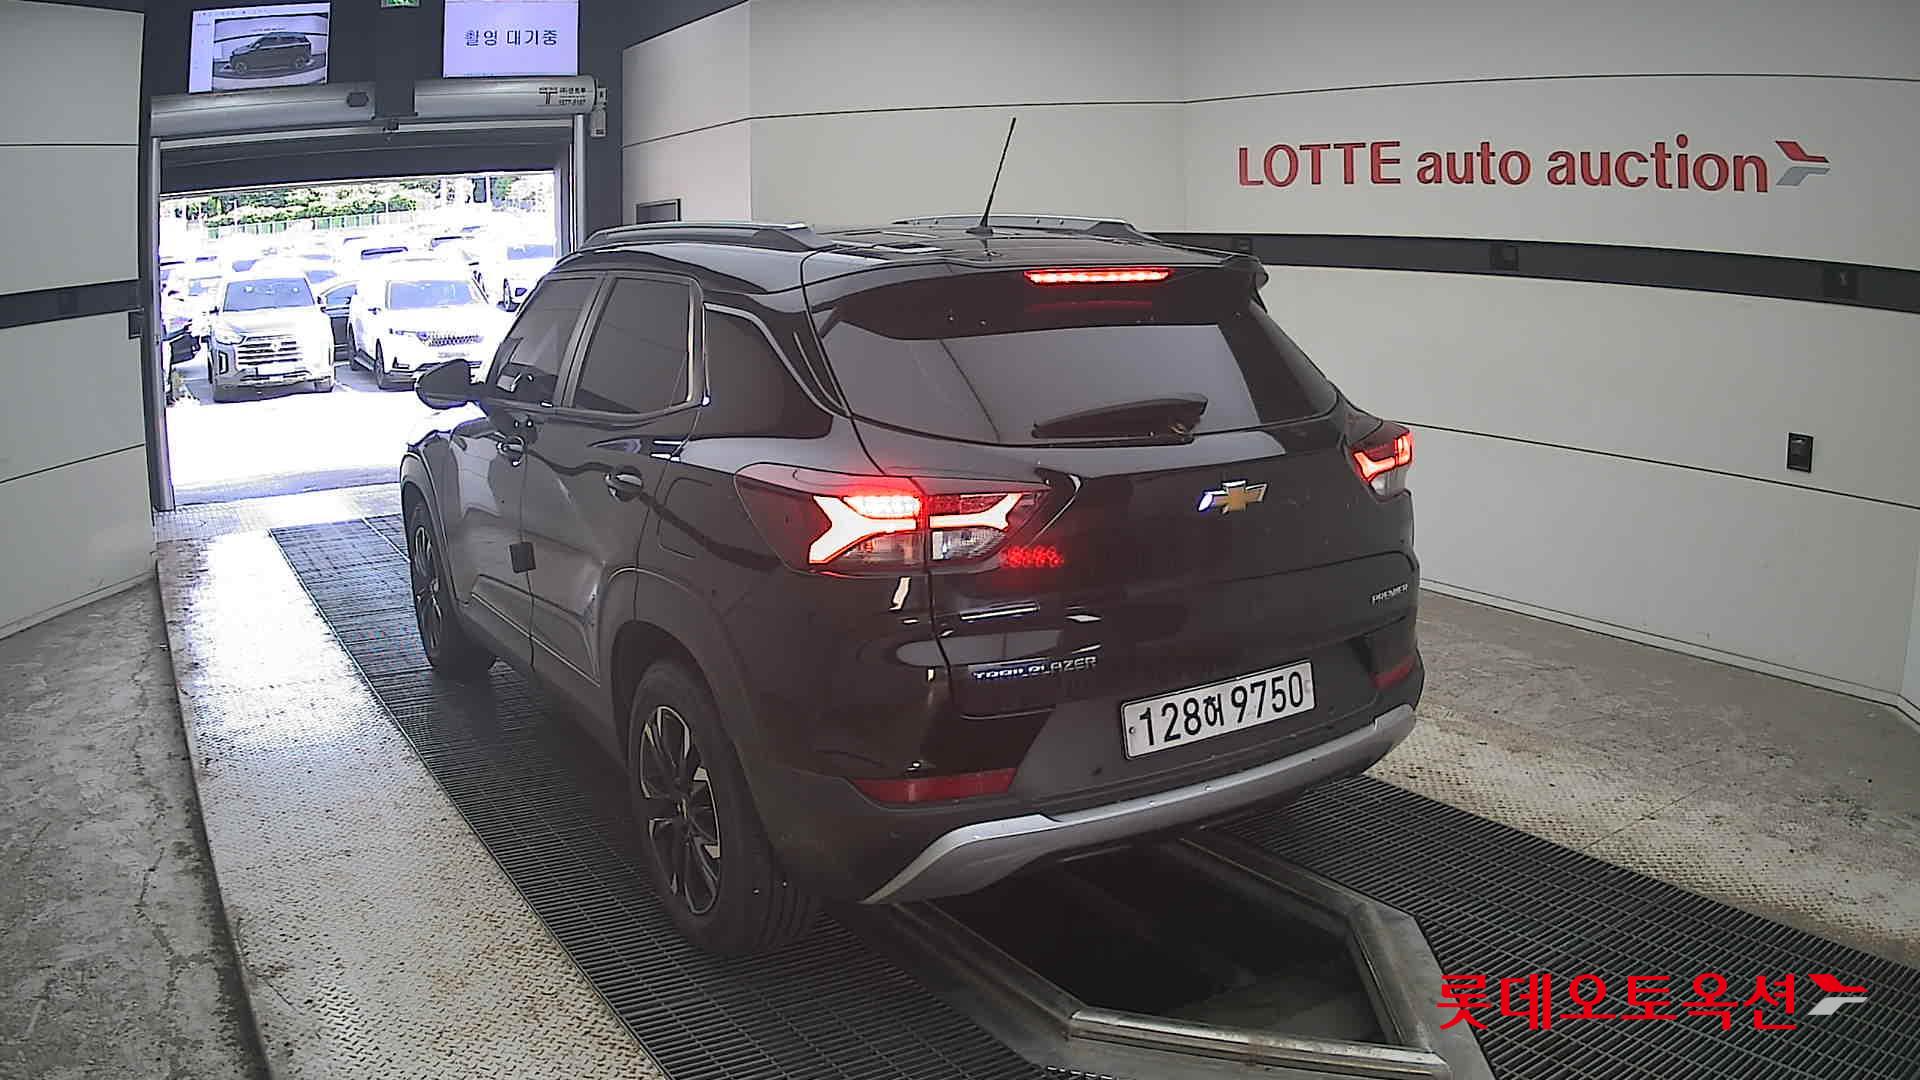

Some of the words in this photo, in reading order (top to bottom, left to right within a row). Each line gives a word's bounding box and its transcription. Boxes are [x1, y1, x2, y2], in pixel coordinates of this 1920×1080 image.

[506, 29, 558, 46] 대기중
[1239, 140, 1401, 187] LOTTE
[1416, 141, 1532, 186] auto
[1546, 133, 1769, 193] auction
[1371, 583, 1409, 604] PREMIER
[973, 656, 1097, 680] TRAILBLAZER
[1139, 693, 1225, 746] 128허
[1230, 671, 1304, 724] 9750
